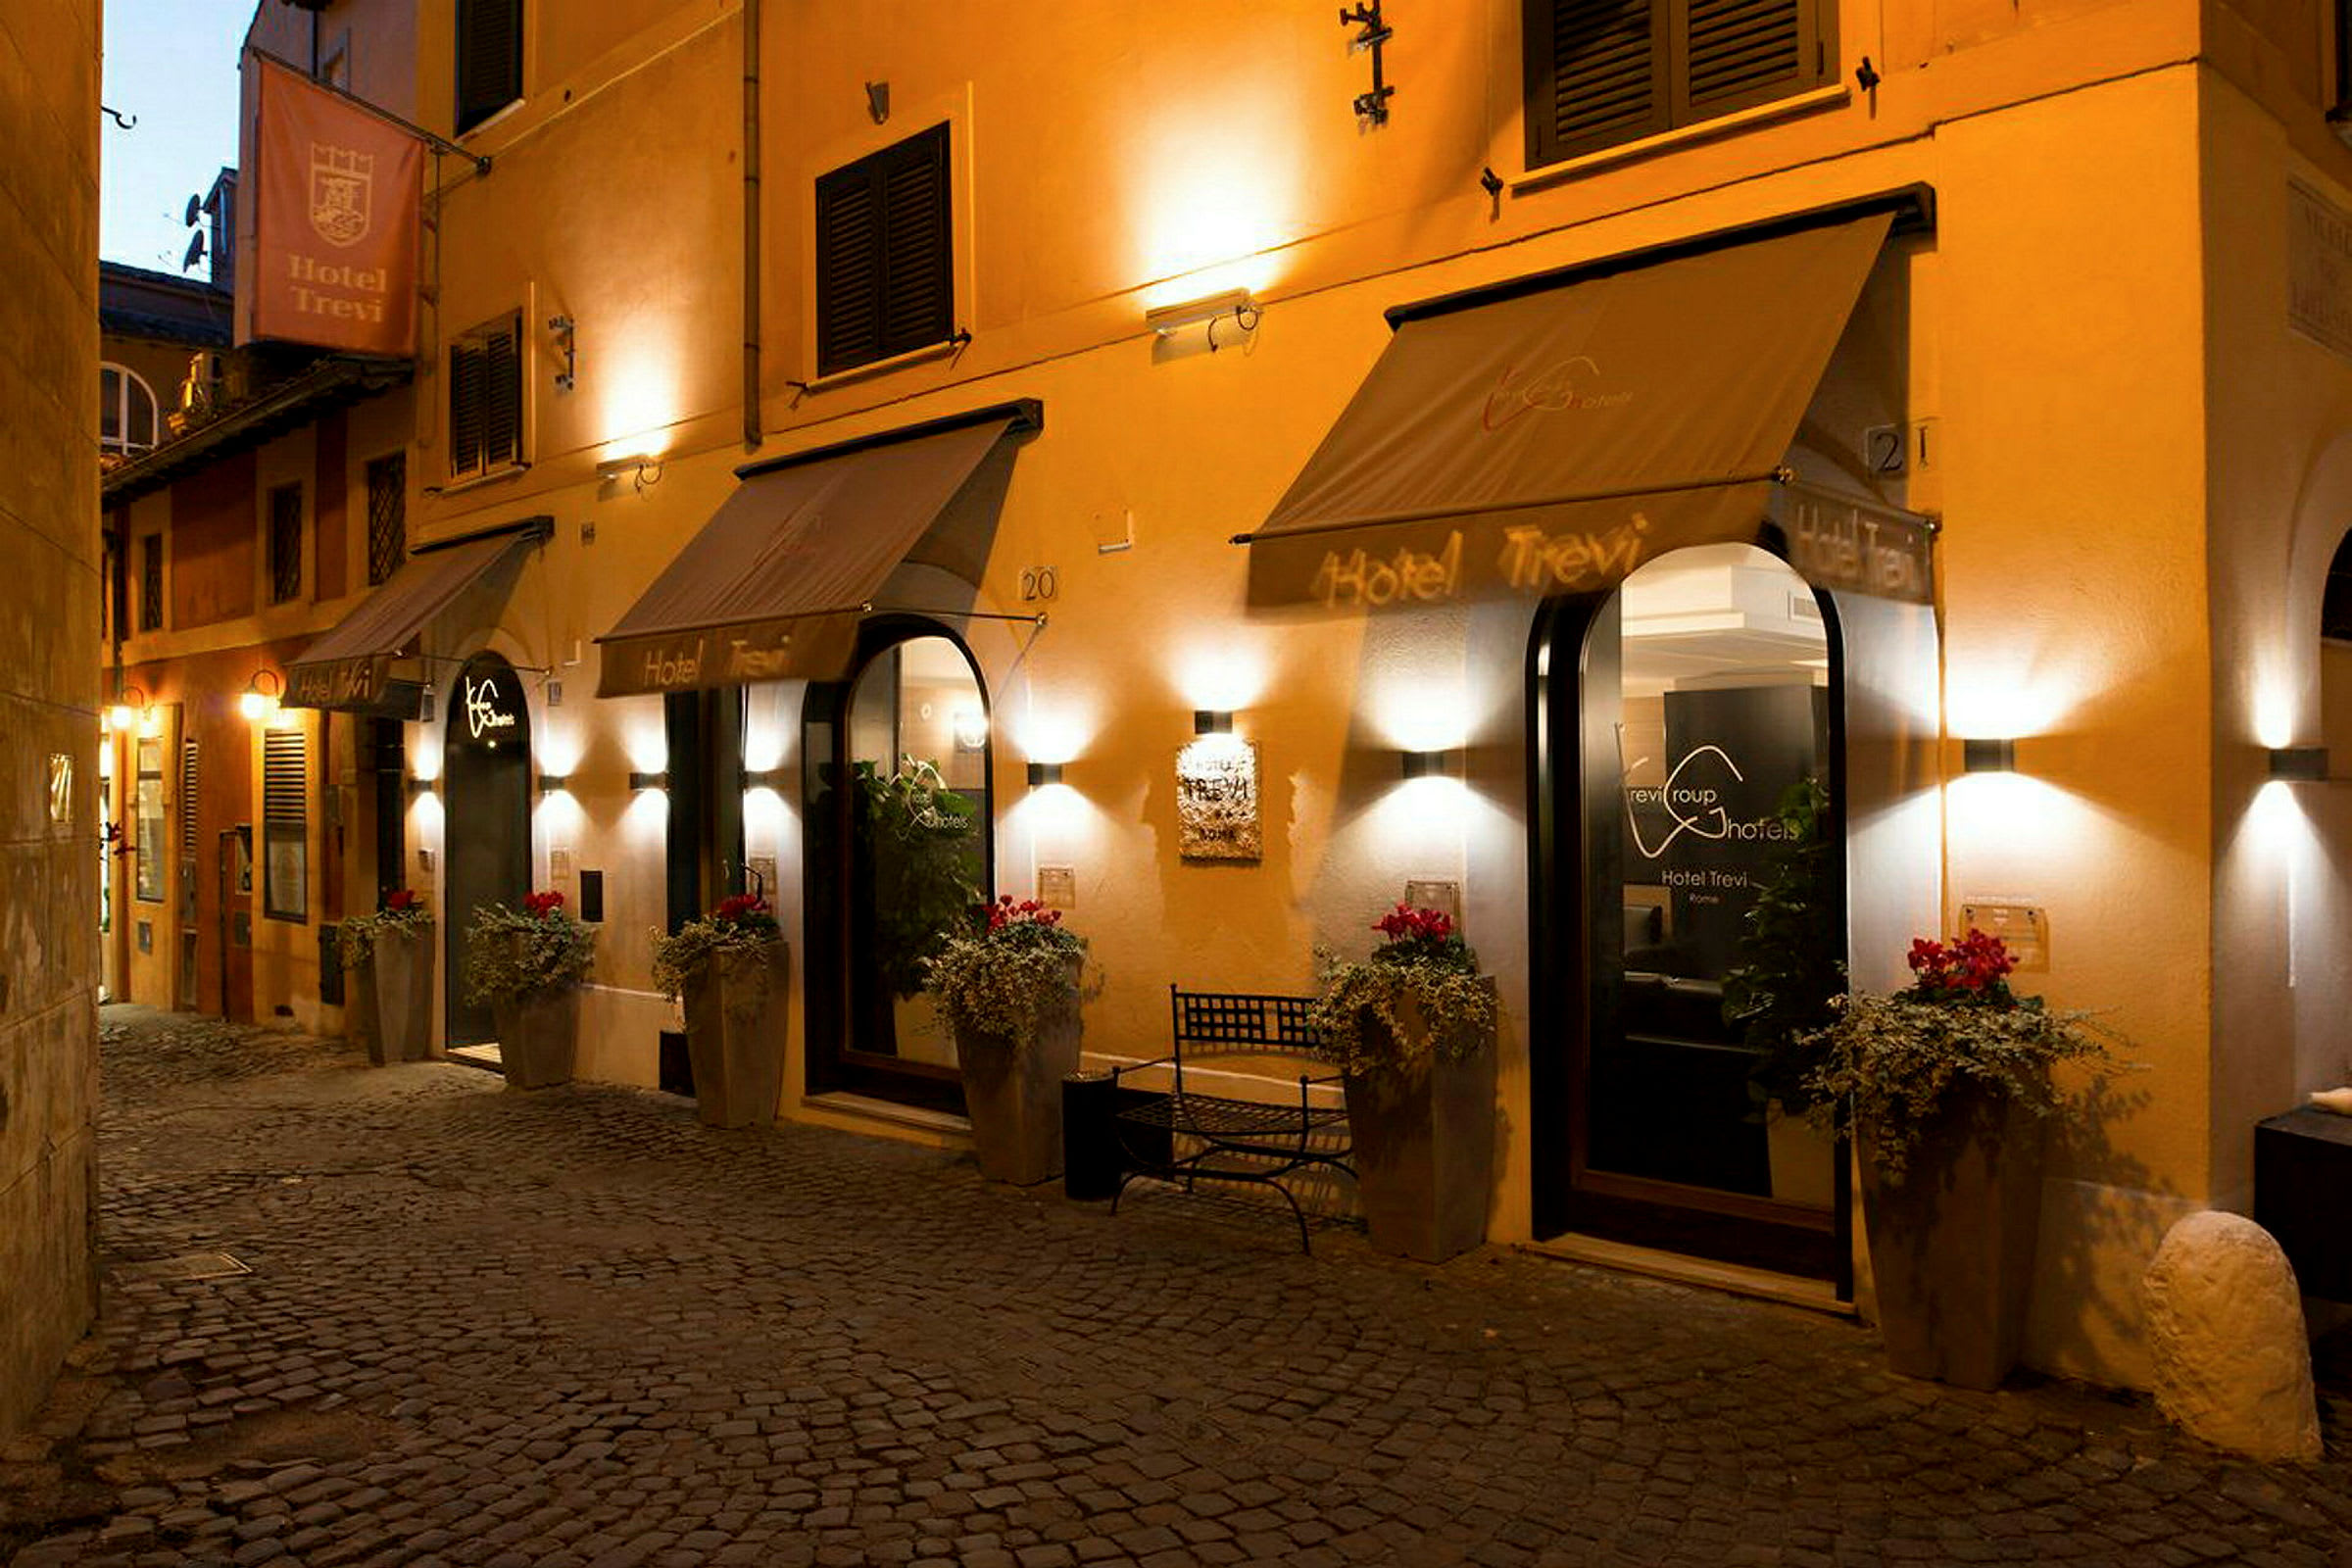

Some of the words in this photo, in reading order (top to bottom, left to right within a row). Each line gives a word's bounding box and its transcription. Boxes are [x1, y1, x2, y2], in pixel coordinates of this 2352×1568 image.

[289, 254, 387, 292] Hotel
[290, 285, 383, 322] Trevi
[1309, 529, 1463, 608] Hotel
[1499, 513, 1650, 588] Trevi
[1798, 504, 1858, 580] Hotel
[1022, 570, 1054, 601] 20
[643, 638, 705, 686] Hotel
[1728, 818, 1800, 841] hotels
[1662, 871, 1706, 886] Hotel
[1709, 871, 1748, 888] Trevi
